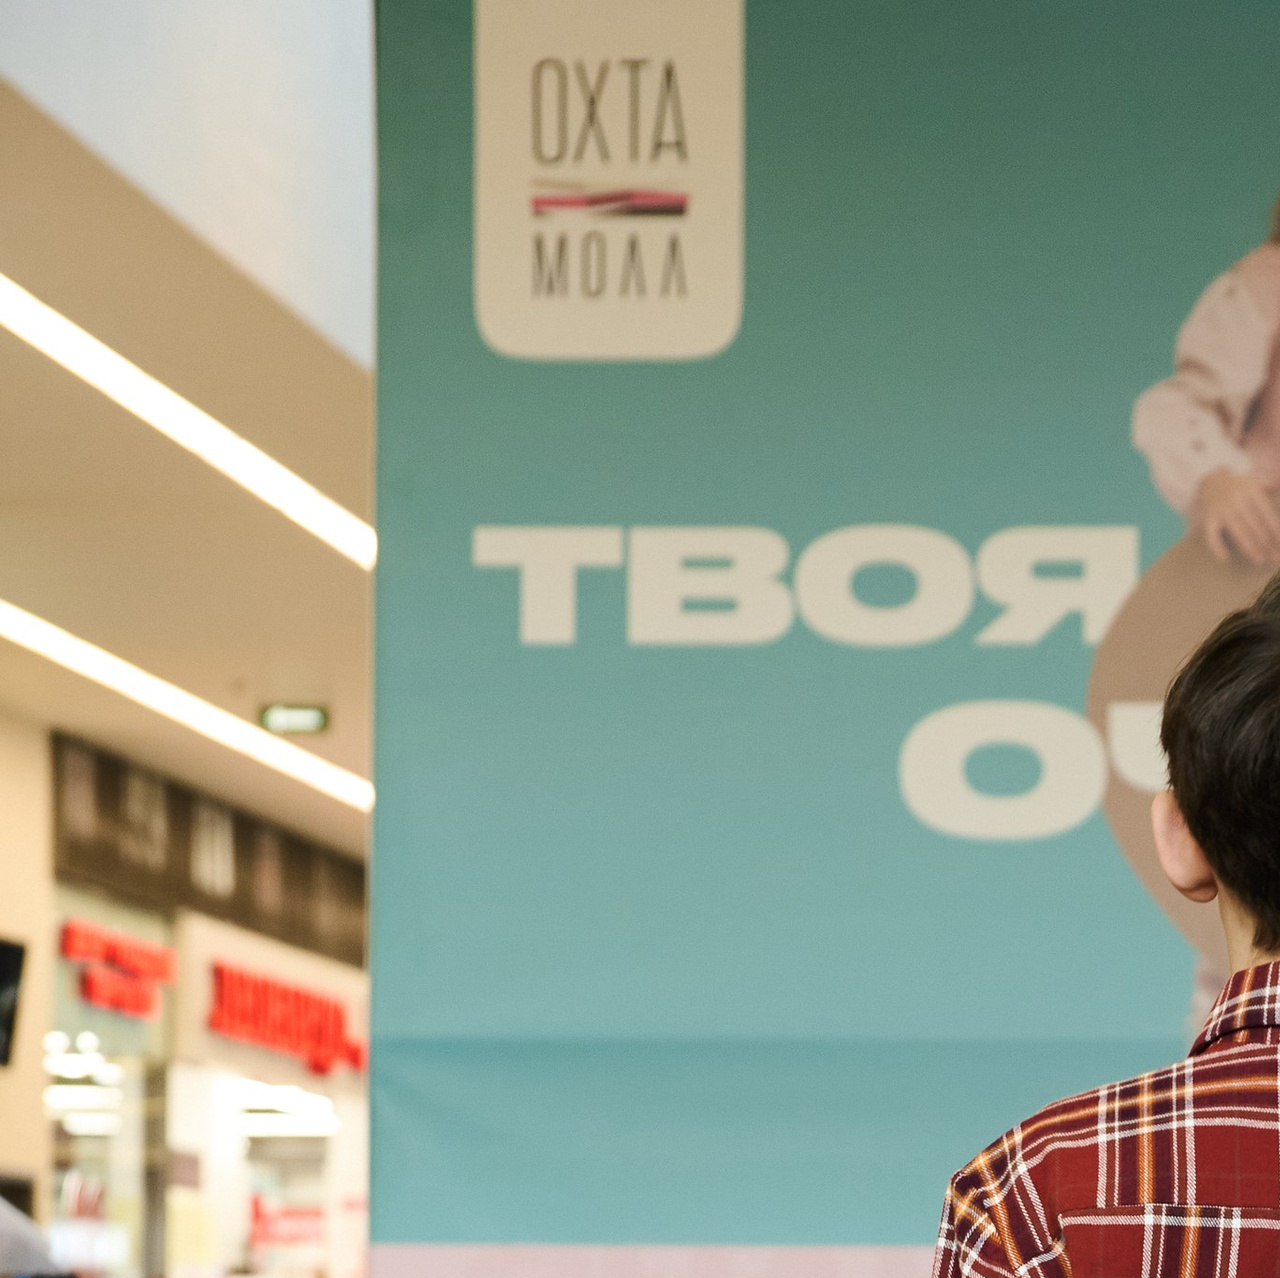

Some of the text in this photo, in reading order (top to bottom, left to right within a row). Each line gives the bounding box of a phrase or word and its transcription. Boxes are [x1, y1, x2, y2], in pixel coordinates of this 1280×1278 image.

[531, 56, 690, 168] ОХТА
[531, 229, 690, 301] МОЛЛ
[472, 522, 1140, 649] ТВОЯ
